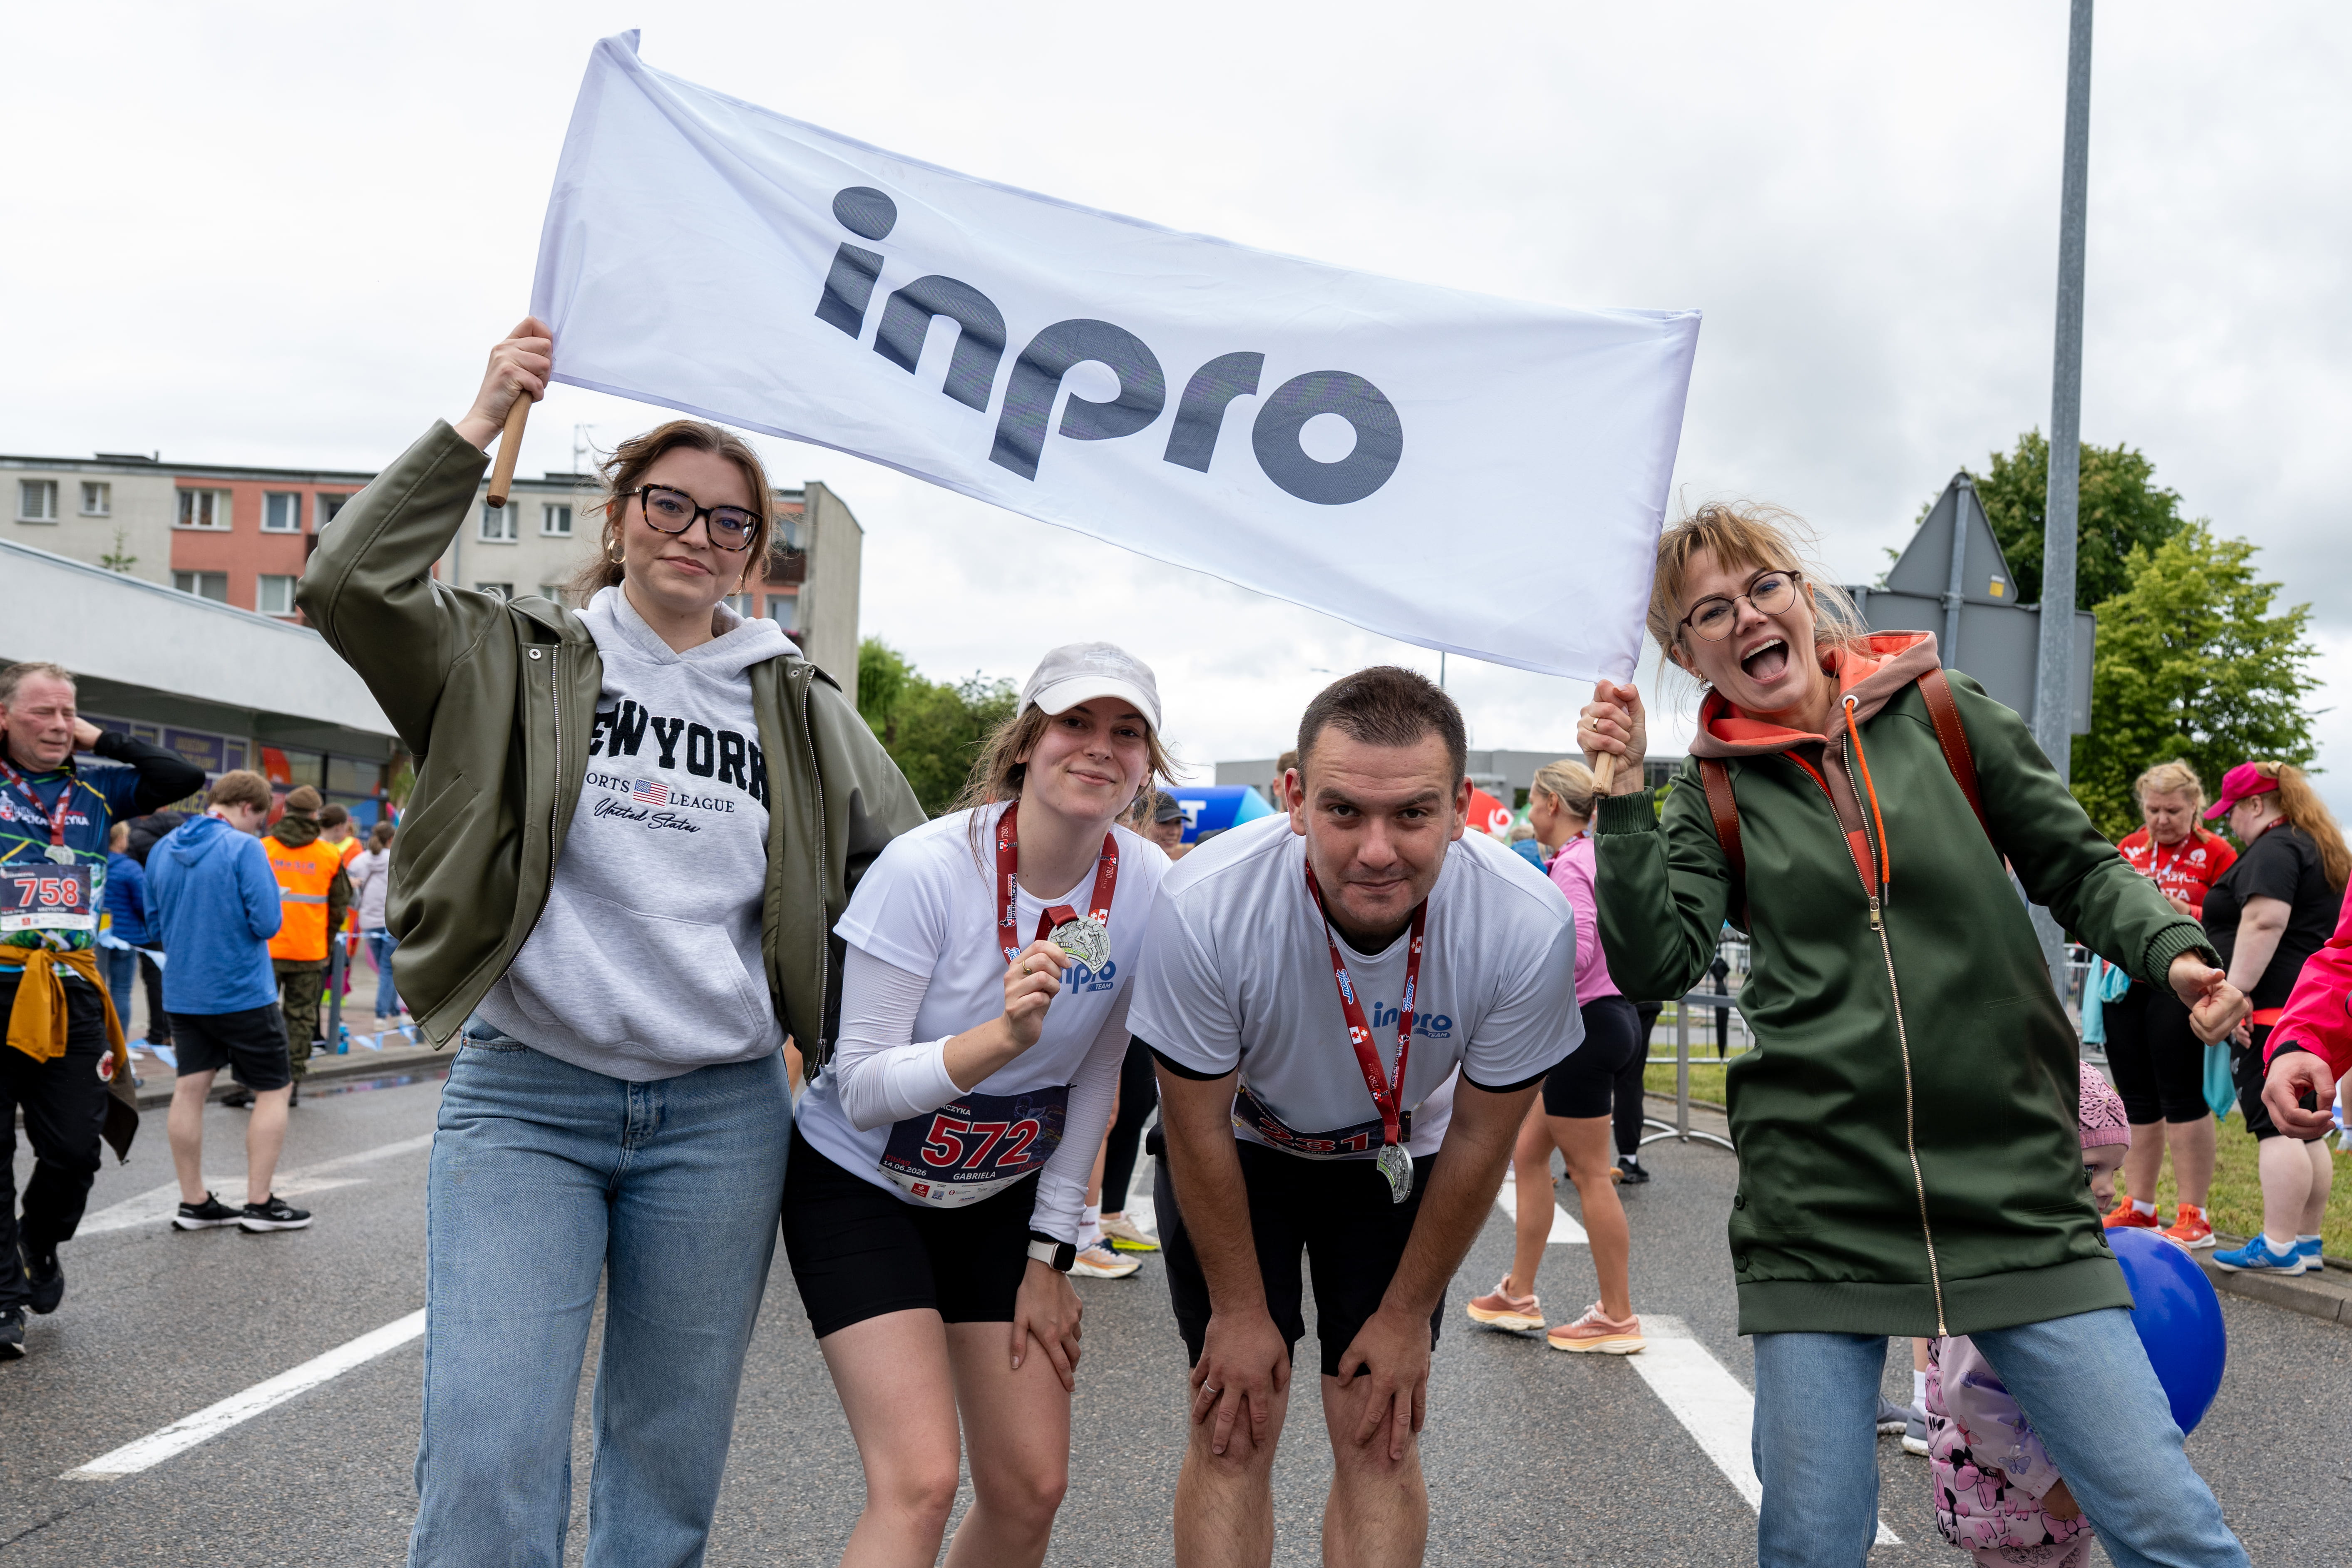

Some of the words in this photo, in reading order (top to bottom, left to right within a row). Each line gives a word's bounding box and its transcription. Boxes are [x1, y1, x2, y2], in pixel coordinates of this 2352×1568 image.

[814, 186, 1403, 505] inpro
[586, 772, 631, 793] ORTS
[669, 792, 735, 813] LEAGUE
[594, 797, 649, 821] United
[648, 813, 701, 833] States
[14, 878, 80, 907] 758
[921, 1113, 1040, 1169] 572
[1259, 1117, 1368, 1152] 231
[883, 1160, 927, 1176] 14.06.2026
[886, 1154, 911, 1166] Elbląg
[953, 1171, 996, 1180] GABRIELA
